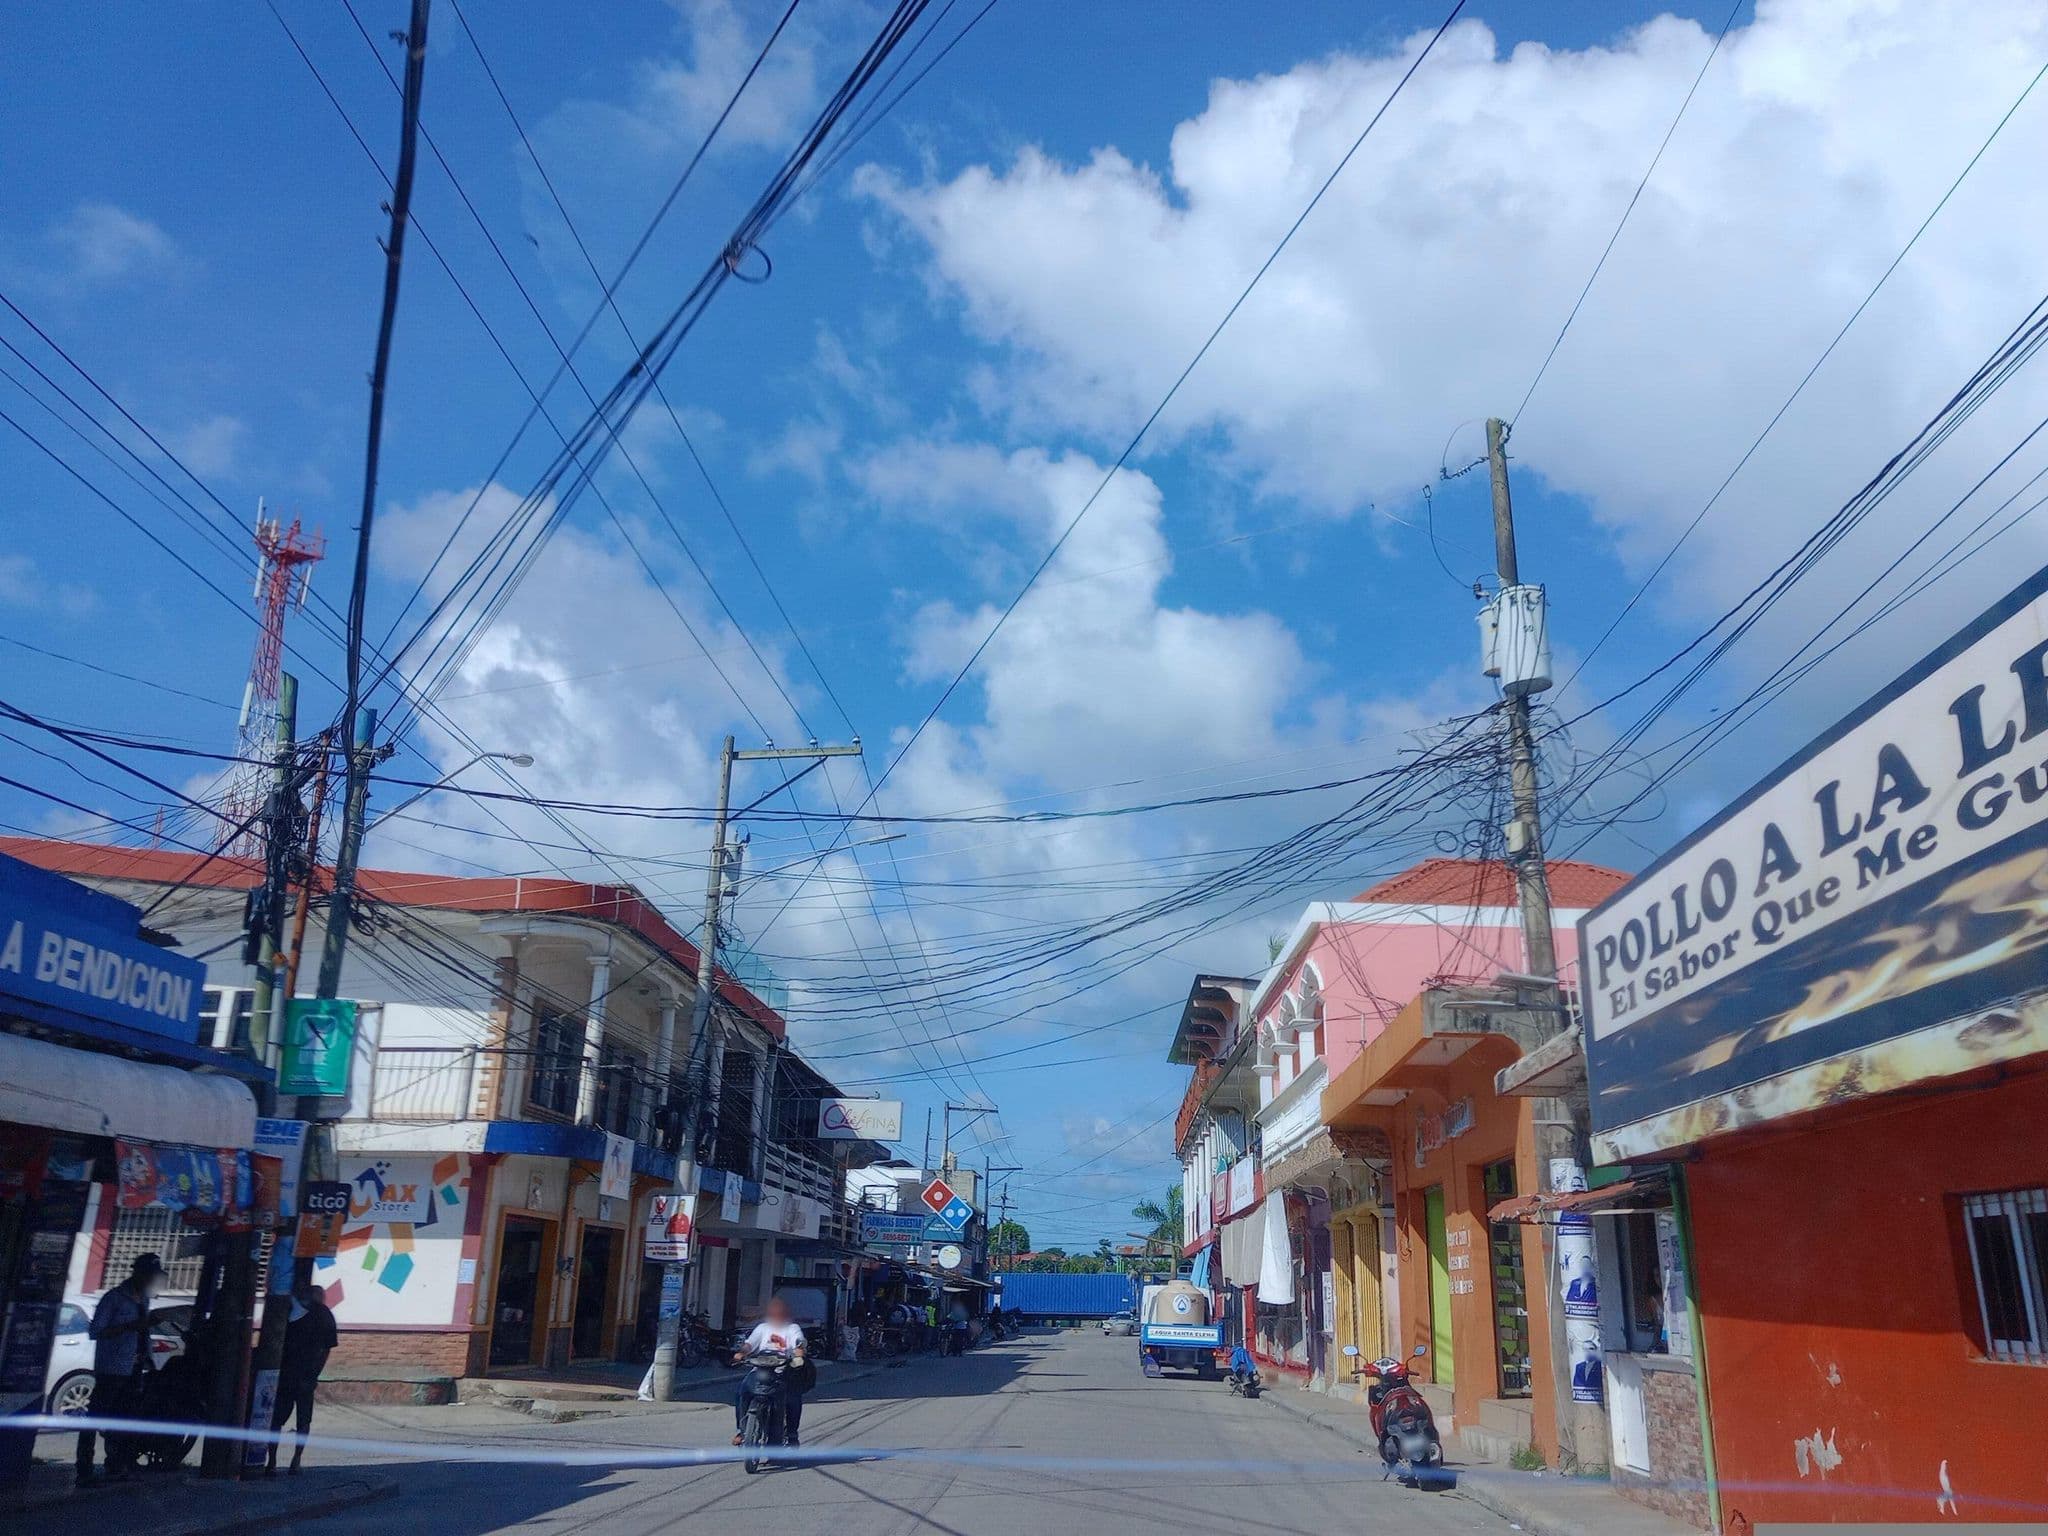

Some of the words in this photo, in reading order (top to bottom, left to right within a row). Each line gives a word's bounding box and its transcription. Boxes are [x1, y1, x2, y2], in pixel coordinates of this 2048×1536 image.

[1594, 857, 1738, 990] POLLO
[1753, 822, 1803, 898] A
[1813, 743, 1932, 858] LA
[1609, 984, 1639, 1020] El
[1644, 927, 1742, 1001] Sabor
[1751, 873, 1841, 946] Que
[1852, 823, 1939, 891] Me
[35, 930, 192, 1024] BENDICION
[373, 1200, 410, 1212] Store
